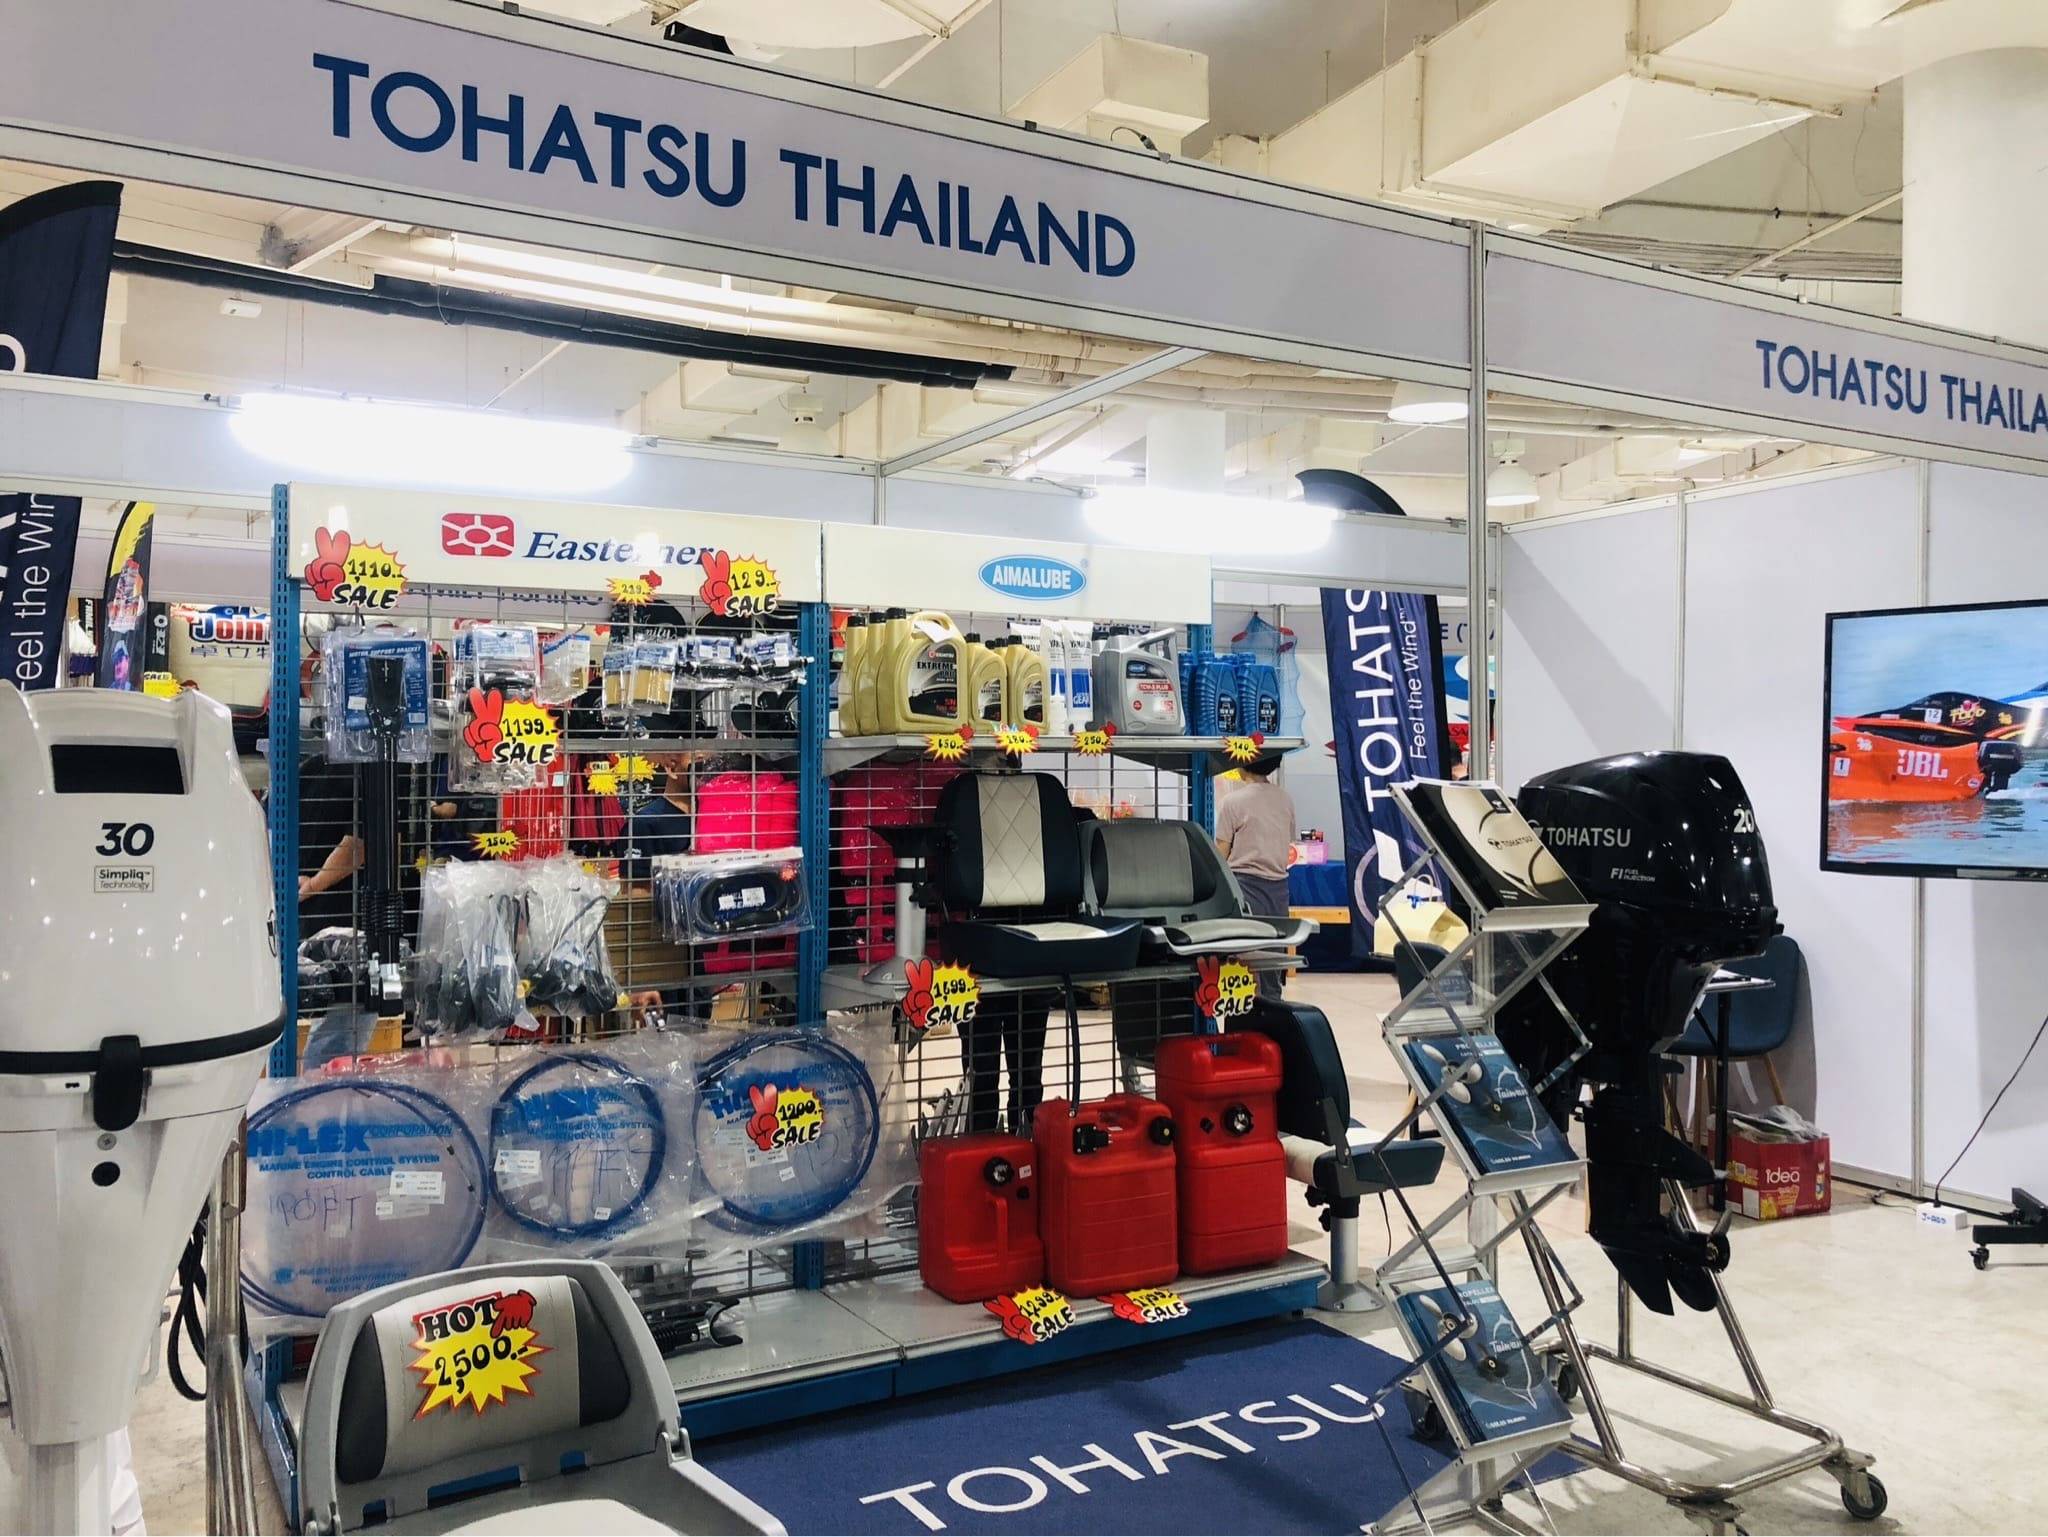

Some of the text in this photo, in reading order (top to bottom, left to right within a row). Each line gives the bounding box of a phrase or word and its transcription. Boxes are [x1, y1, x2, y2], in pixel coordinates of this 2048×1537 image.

[313, 53, 1136, 278] TOHATSU THAILAND
[1756, 339, 1927, 414] TOHATSU
[522, 531, 714, 565] Eastener
[993, 565, 1071, 590] AIMALUBE
[10, 494, 55, 692] eel the Win
[333, 584, 397, 608] SALE
[726, 594, 776, 616] SALE
[190, 613, 270, 644] Join
[917, 661, 955, 671] EXTREME
[1345, 588, 1403, 812] TOHATS
[1406, 678, 1422, 714] the
[1408, 716, 1427, 758] Feel
[494, 742, 555, 764] SALE
[1898, 748, 1949, 779] JBL
[1733, 808, 1755, 833] 20
[95, 822, 155, 857] 30
[1501, 836, 1533, 849] TOHATSU
[1547, 827, 1632, 848] TOHATSU
[99, 880, 150, 891] Technology
[1610, 867, 1624, 880] FI
[926, 1001, 976, 1027] SALE
[1213, 995, 1254, 1017] SALE
[1495, 1087, 1528, 1099] Taiwan
[246, 1119, 453, 1158] HI-LEX CORPORATION
[772, 1121, 820, 1148] SALE
[259, 1154, 440, 1172] MARINE ENGINE CONTROL SYSTEM
[307, 1169, 357, 1180] CONTROL
[1766, 1167, 1800, 1184] idea
[420, 1297, 500, 1342] HOT
[1032, 1307, 1074, 1340] SALE
[1143, 1301, 1186, 1321] SALE
[859, 1383, 1387, 1532] TOHATSU
